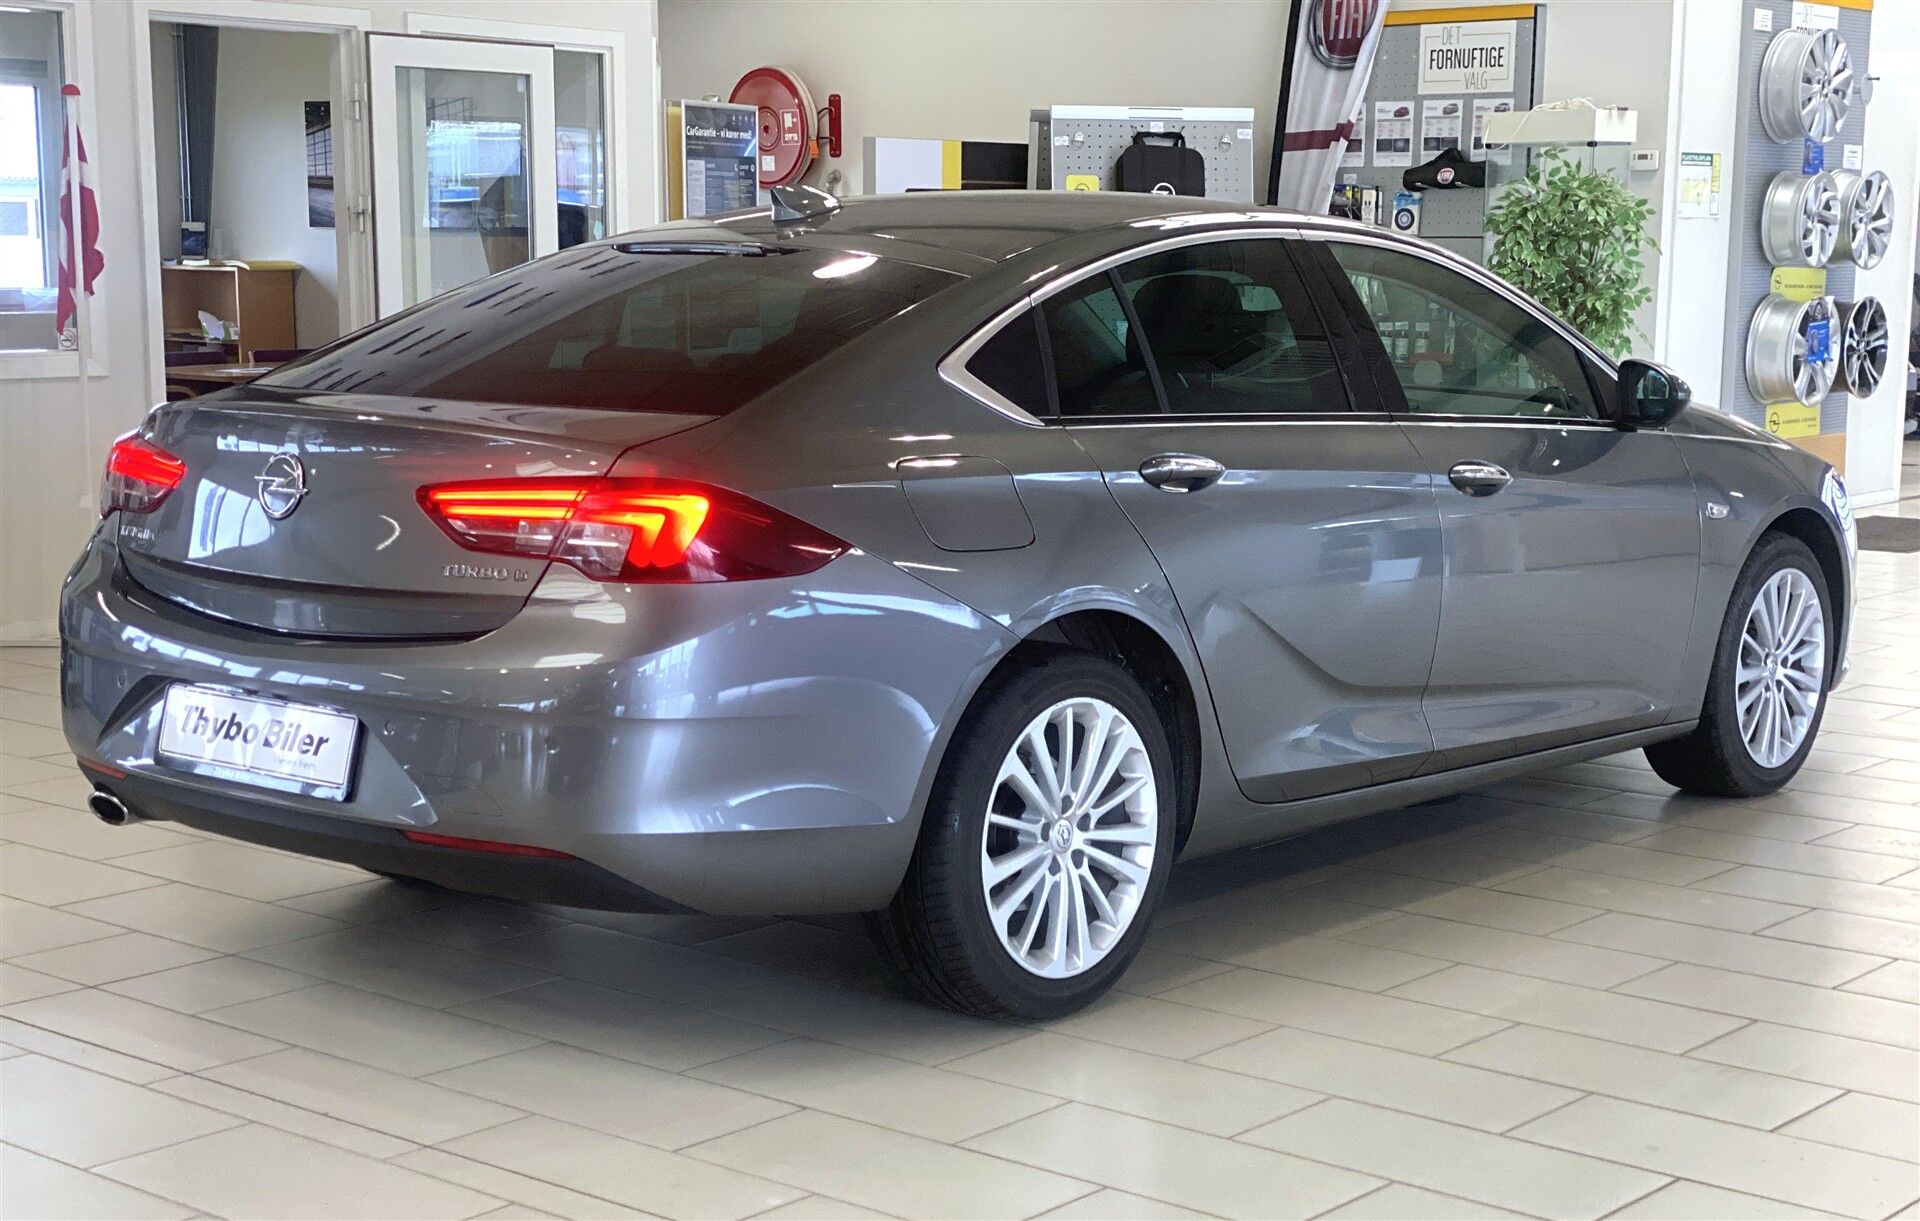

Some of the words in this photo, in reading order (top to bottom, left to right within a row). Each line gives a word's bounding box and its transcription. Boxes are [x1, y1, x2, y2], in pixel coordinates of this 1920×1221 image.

[1442, 26, 1462, 45] DET
[1429, 46, 1505, 70] FORNUFTIGE
[1464, 71, 1488, 90] VALG
[686, 125, 716, 138] CarGarantie
[720, 127, 725, 138] vi
[442, 564, 508, 580] TURBO
[181, 703, 259, 745] Thybo
[262, 718, 330, 757] Biler
